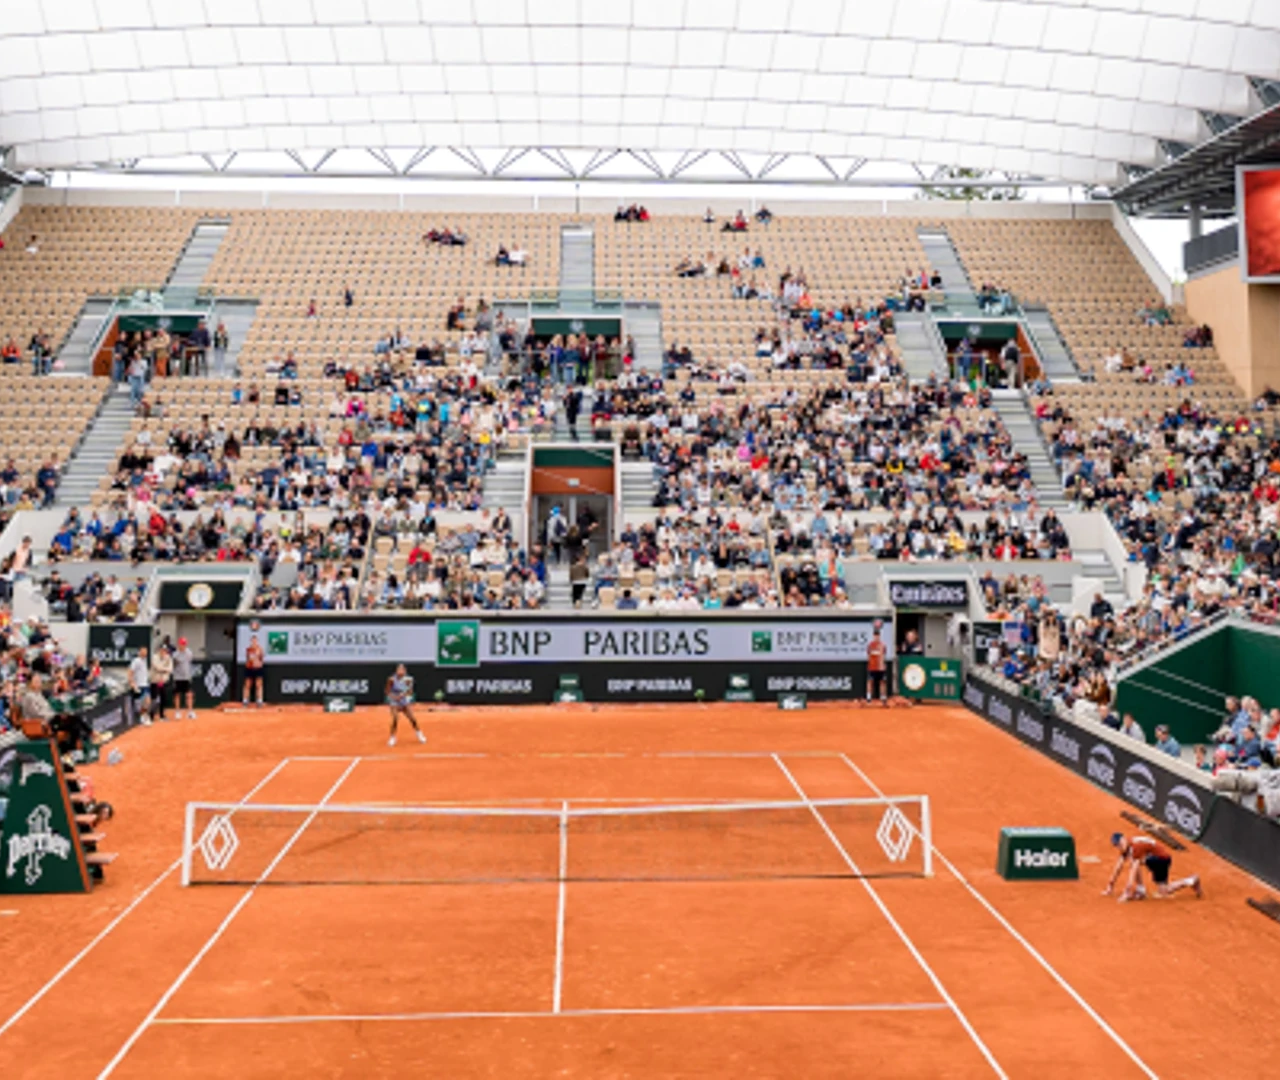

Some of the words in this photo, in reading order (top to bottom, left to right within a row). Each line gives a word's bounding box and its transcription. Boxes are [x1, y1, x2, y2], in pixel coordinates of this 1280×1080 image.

[891, 583, 965, 602] Emirates
[489, 630, 552, 656] BNP
[583, 629, 710, 656] PARIBAS
[1013, 847, 1069, 868] Haier
